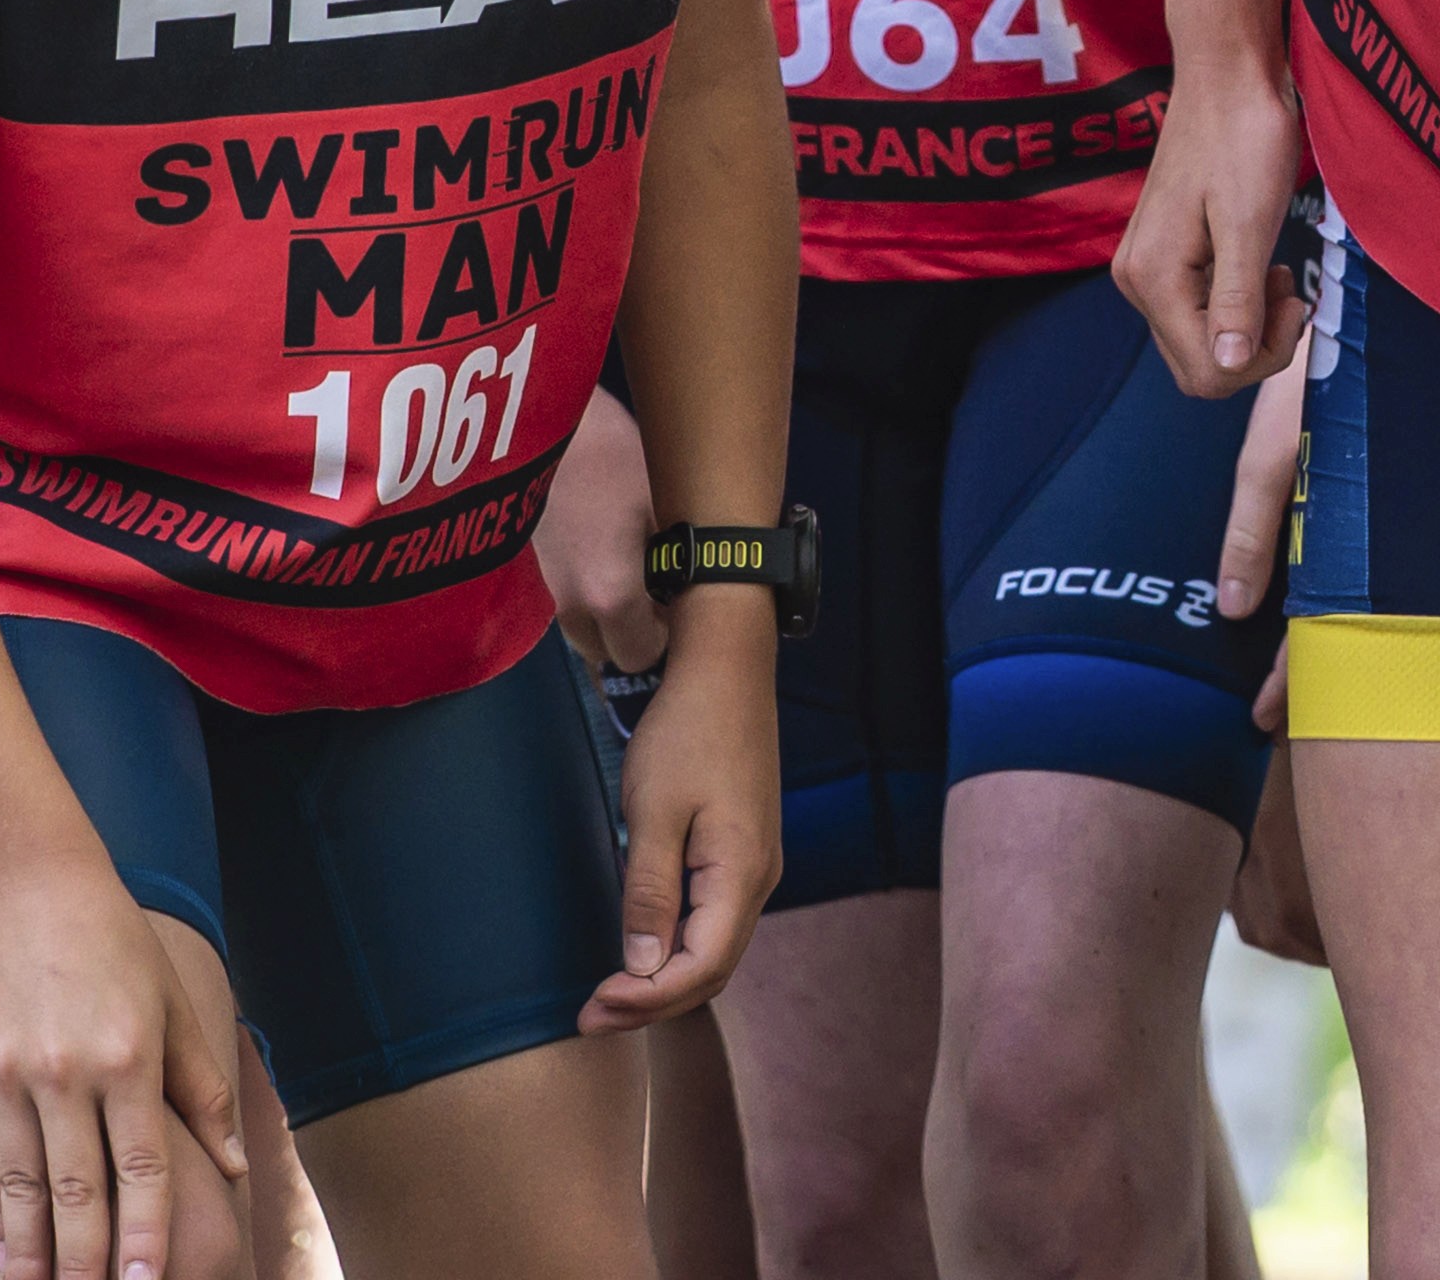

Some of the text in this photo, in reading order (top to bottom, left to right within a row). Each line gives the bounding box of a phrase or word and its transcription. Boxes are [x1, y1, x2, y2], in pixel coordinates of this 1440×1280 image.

[135, 53, 657, 226] SWIMRUN
[795, 123, 1055, 181] FRANCE
[283, 187, 575, 350] MAN
[287, 322, 537, 506] 1061
[370, 490, 514, 586] FRANCE
[995, 566, 1175, 607] FOCUS
